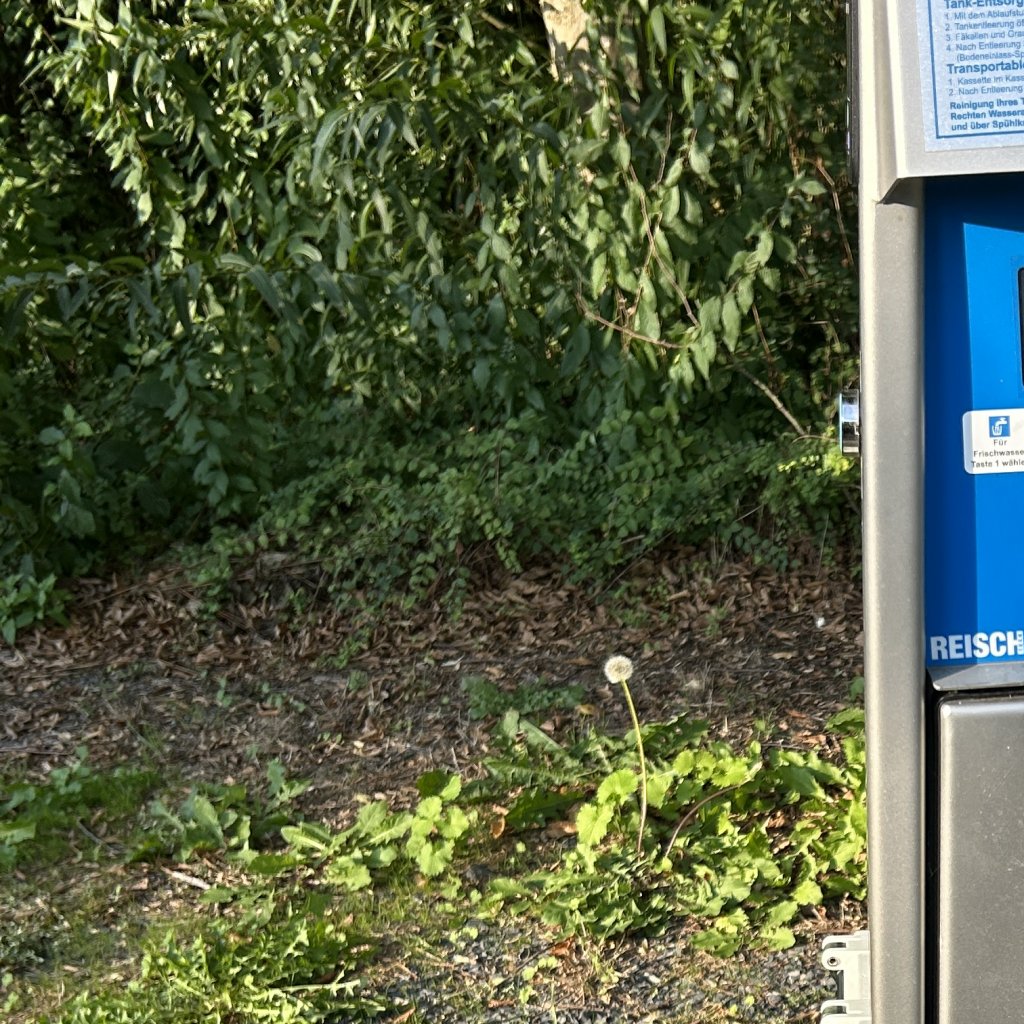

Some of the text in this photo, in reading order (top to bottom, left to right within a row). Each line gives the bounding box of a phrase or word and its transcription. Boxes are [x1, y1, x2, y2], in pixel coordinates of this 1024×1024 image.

[954, 12, 966, 20] Mit
[968, 11, 985, 19] dem
[955, 20, 1014, 30] Tankentleerung
[956, 32, 988, 40] Fäkalien
[956, 43, 976, 51] Nach
[979, 41, 1020, 50] Entleerung
[958, 77, 991, 85] Kassette
[959, 87, 978, 95] Nach
[981, 85, 1023, 94] Entleerung
[950, 100, 994, 110] Reinigung
[996, 98, 1018, 106] Ihres
[950, 111, 986, 120] Rechten
[951, 122, 967, 131] und
[970, 121, 990, 130] über
[971, 460, 992, 468] Taste
[930, 630, 1024, 660] REISCH
